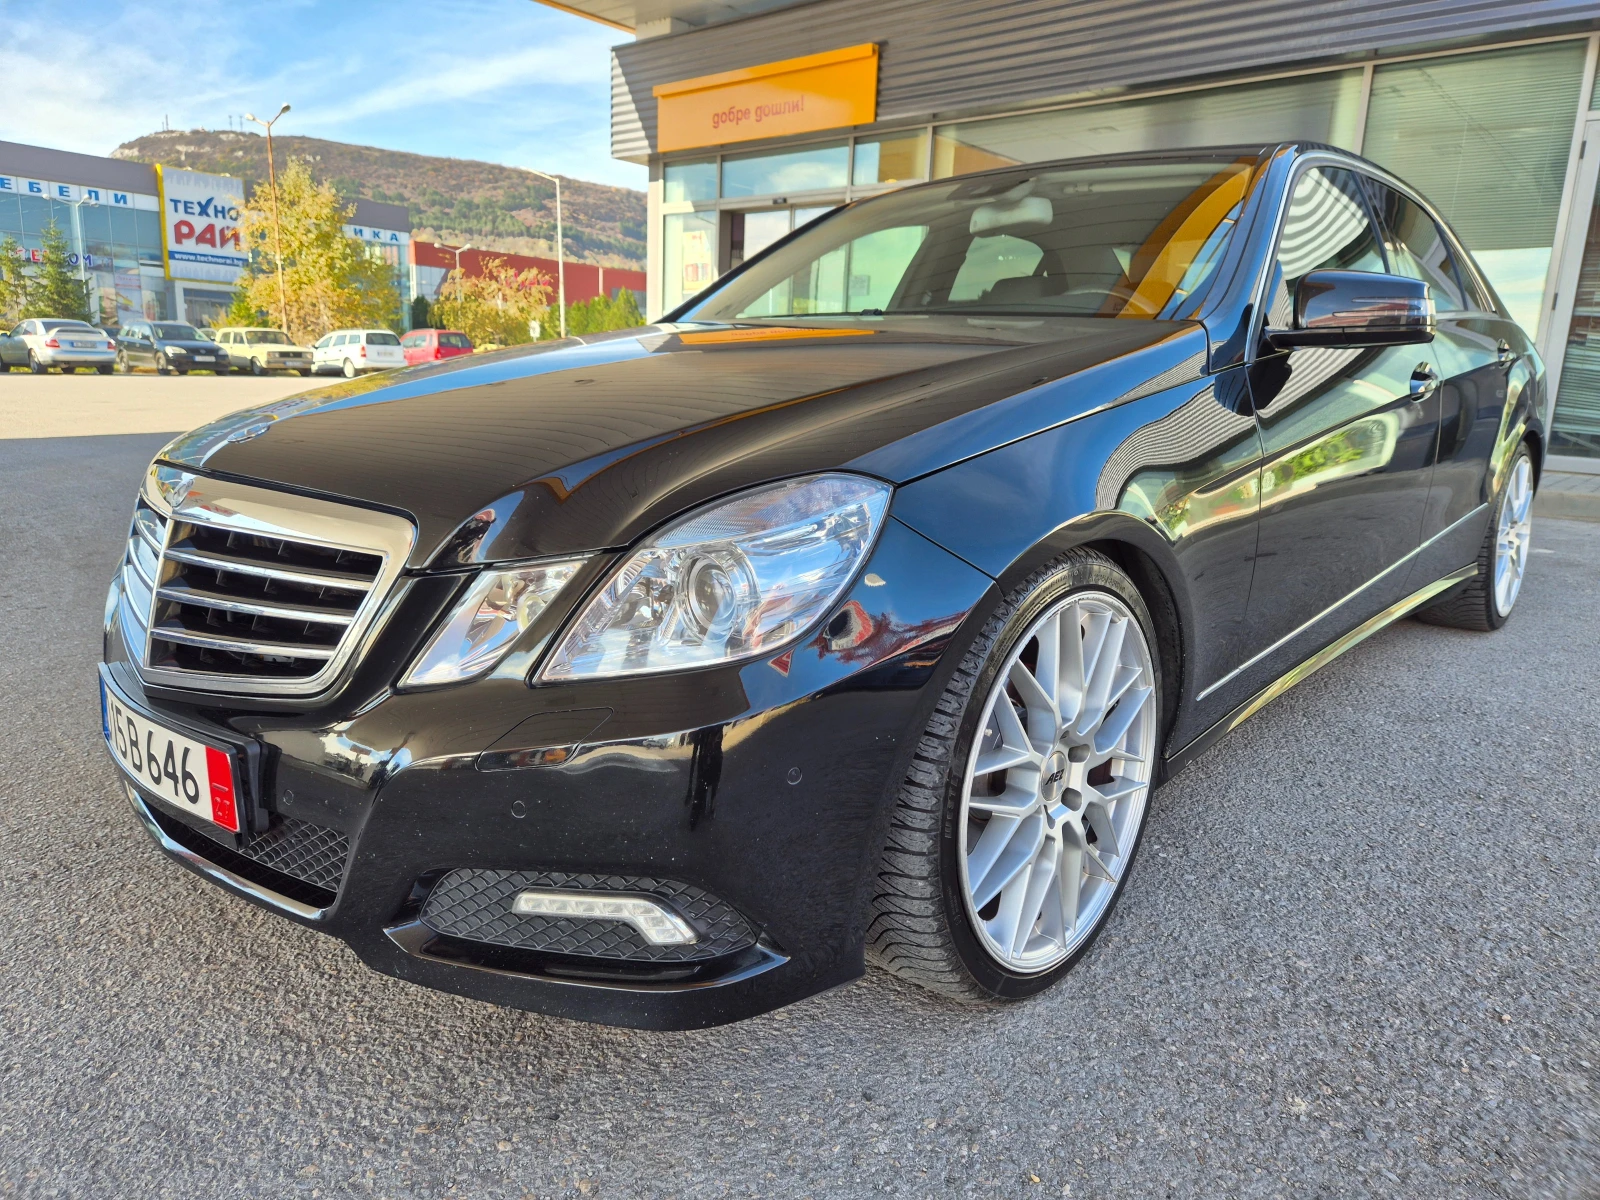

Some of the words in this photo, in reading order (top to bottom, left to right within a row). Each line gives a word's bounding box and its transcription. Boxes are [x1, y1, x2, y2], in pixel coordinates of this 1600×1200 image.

[712, 106, 751, 129] добре
[755, 94, 804, 123] дошли!
[169, 196, 241, 222] ТЕХНО
[1045, 768, 1065, 786] AEZ
